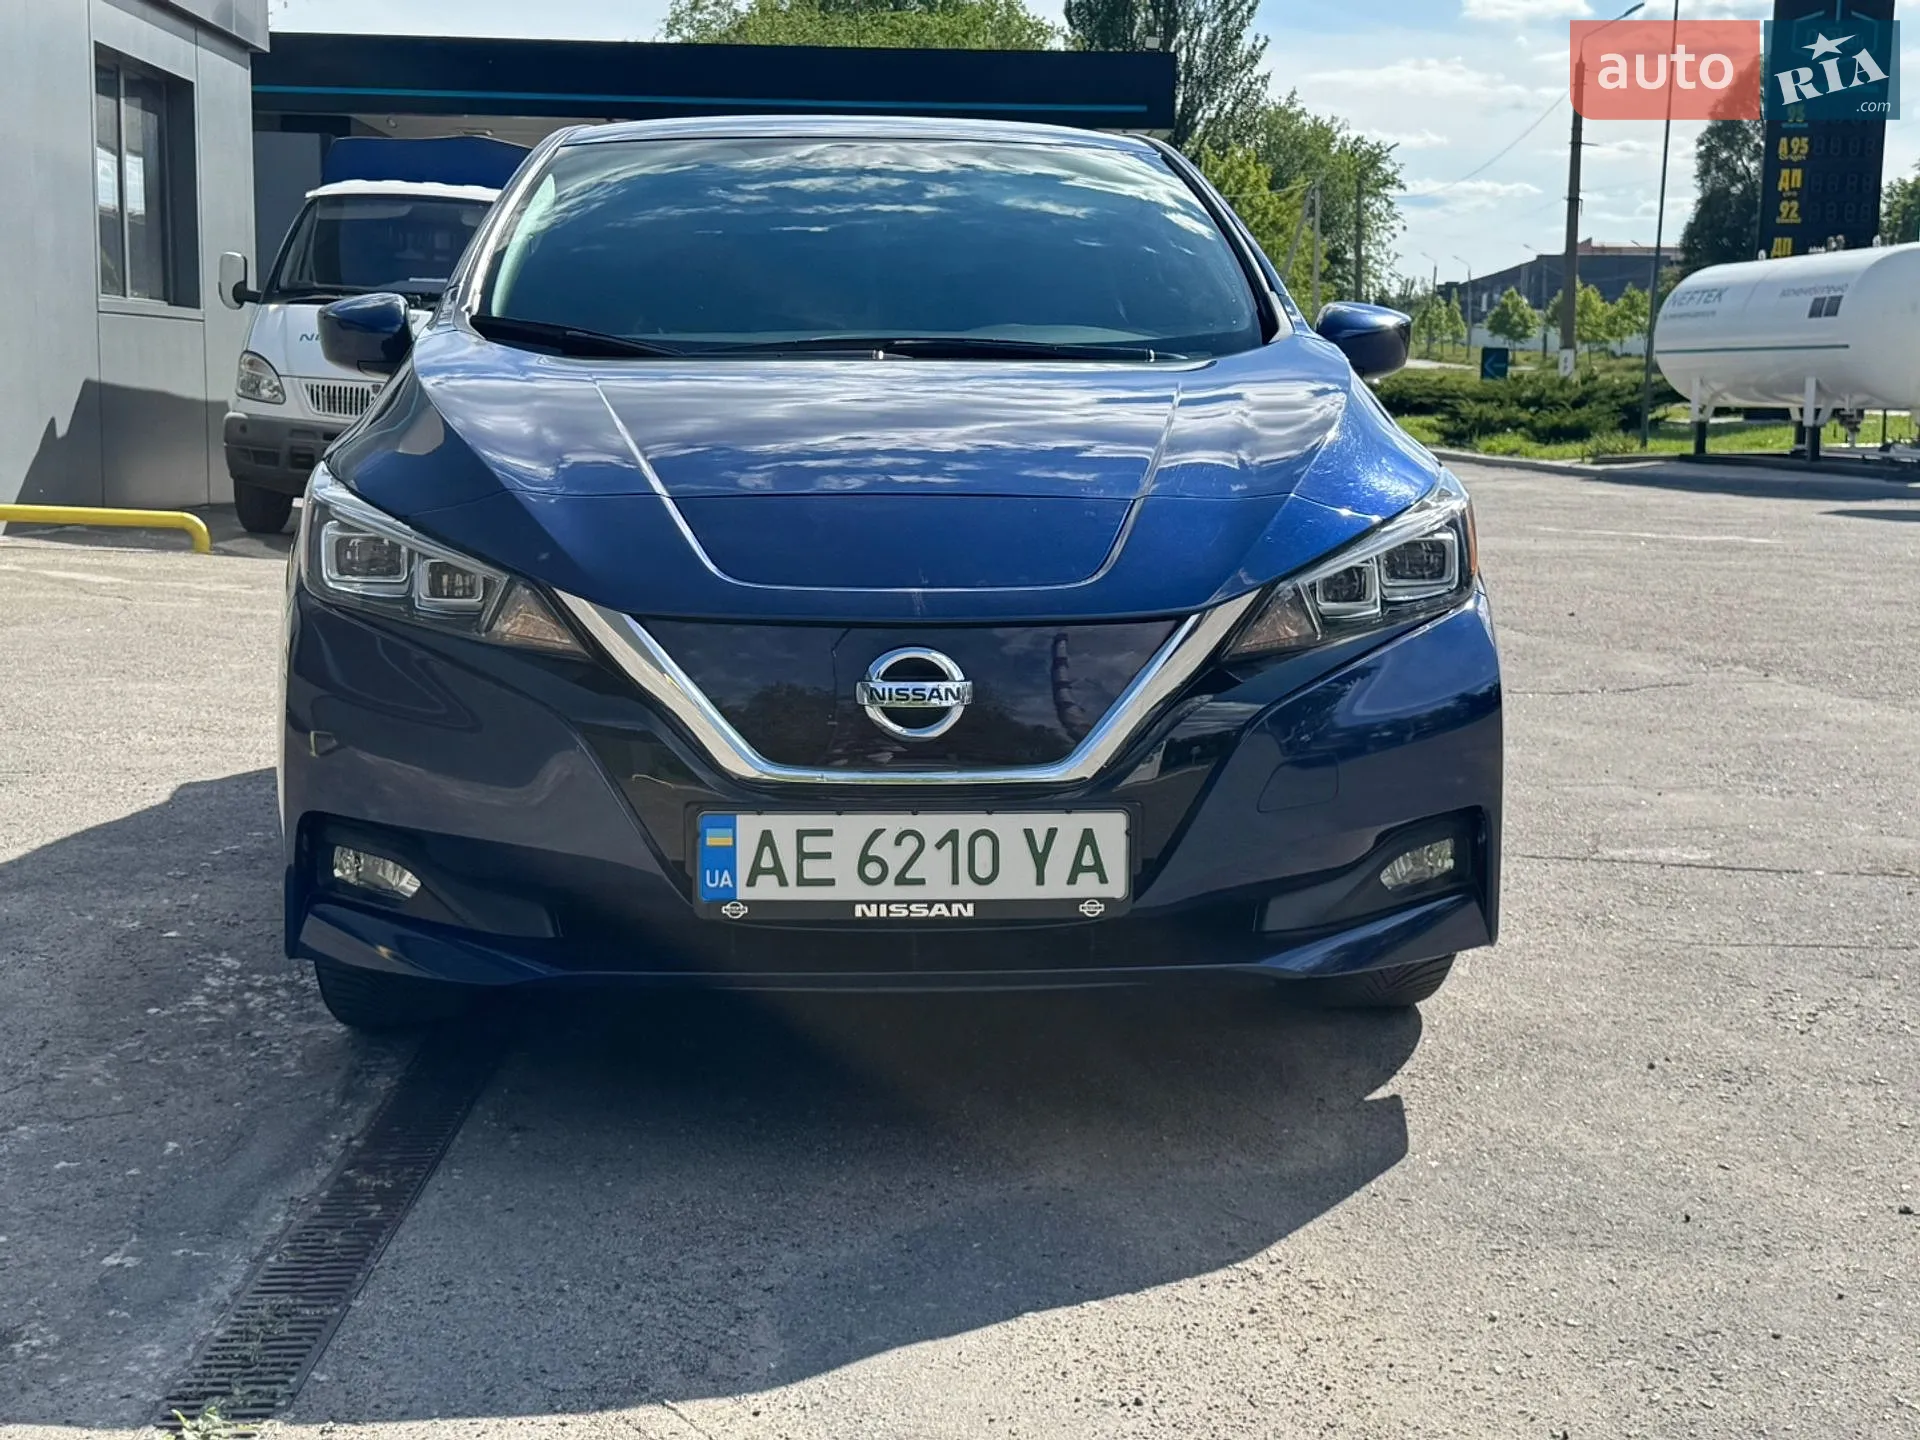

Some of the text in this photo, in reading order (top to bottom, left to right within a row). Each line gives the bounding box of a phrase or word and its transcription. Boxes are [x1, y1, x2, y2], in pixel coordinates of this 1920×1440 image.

[869, 686, 961, 702] NISSAN
[745, 827, 1110, 888] AE 6210 YA
[705, 869, 734, 889] UA
[854, 902, 975, 918] NISSAN
